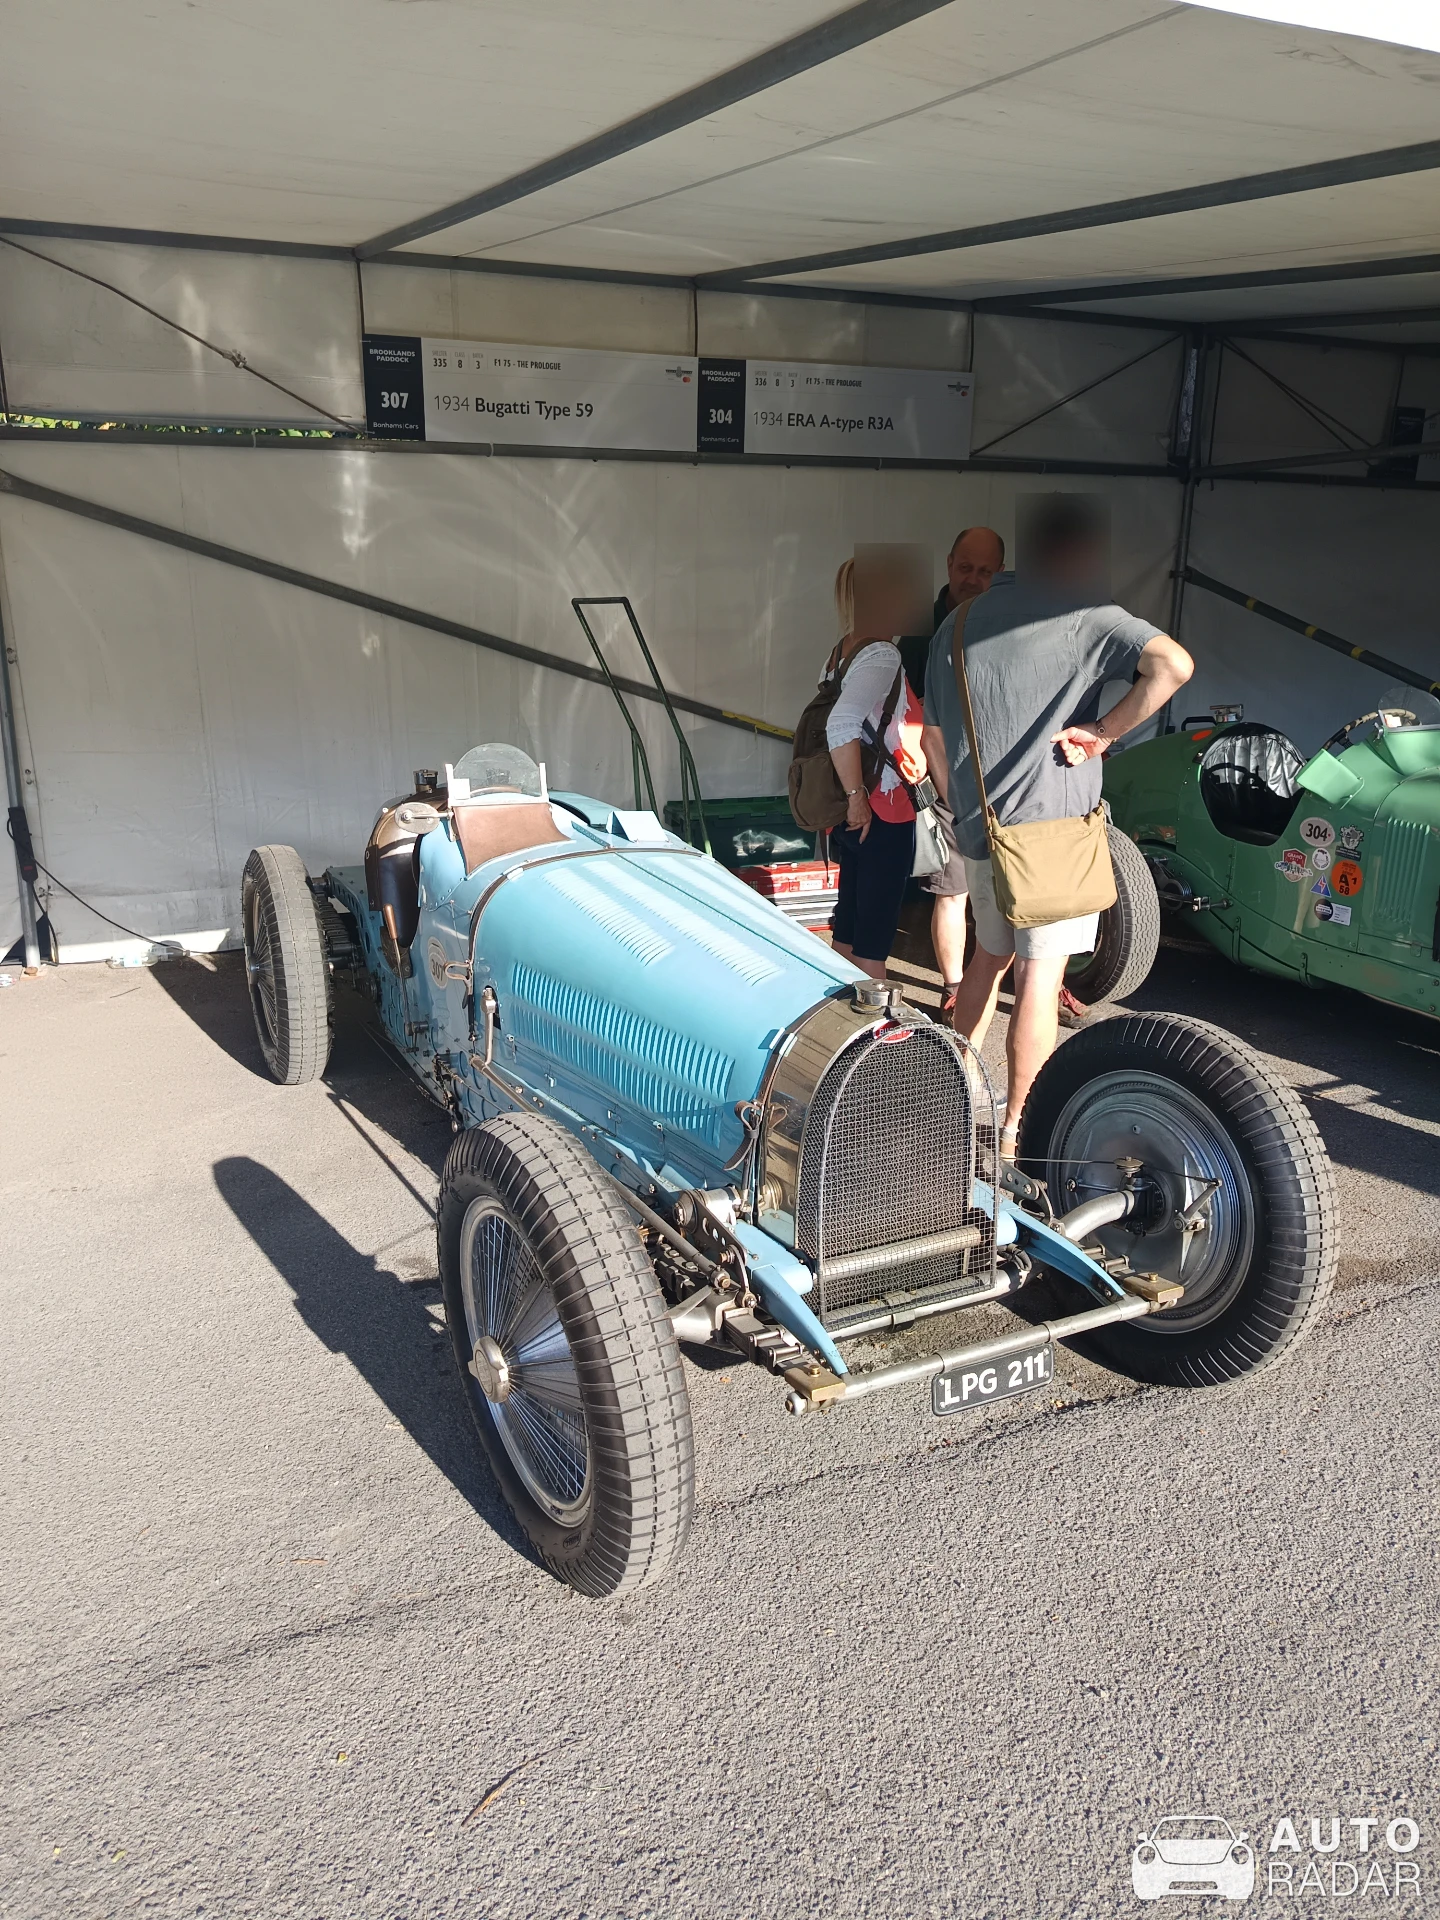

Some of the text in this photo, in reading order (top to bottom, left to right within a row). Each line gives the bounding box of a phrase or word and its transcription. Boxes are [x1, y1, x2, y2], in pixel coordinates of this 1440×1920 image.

[369, 348, 415, 357] BROOKLANDS
[433, 358, 481, 369] 335 8 3
[494, 358, 501, 366] F1
[503, 359, 511, 367] 75
[517, 360, 528, 368] THE
[530, 361, 561, 370] PROLOGUE
[702, 369, 741, 377] BROOKLANDS
[755, 377, 795, 388] 336 8 3
[806, 377, 812, 385] F1
[825, 378, 835, 386] THE
[836, 379, 862, 388] PROLOGUE
[381, 391, 409, 409] 307
[434, 394, 594, 420] 1934 Bugatti Type 59
[709, 408, 733, 424] 304
[753, 411, 894, 433] 1934 ERA A-type R3A
[1306, 824, 1327, 841] 304
[1339, 874, 1350, 887] A
[1339, 885, 1350, 896] 58
[432, 958, 444, 981] 307
[943, 1351, 1046, 1405] LPG 211
